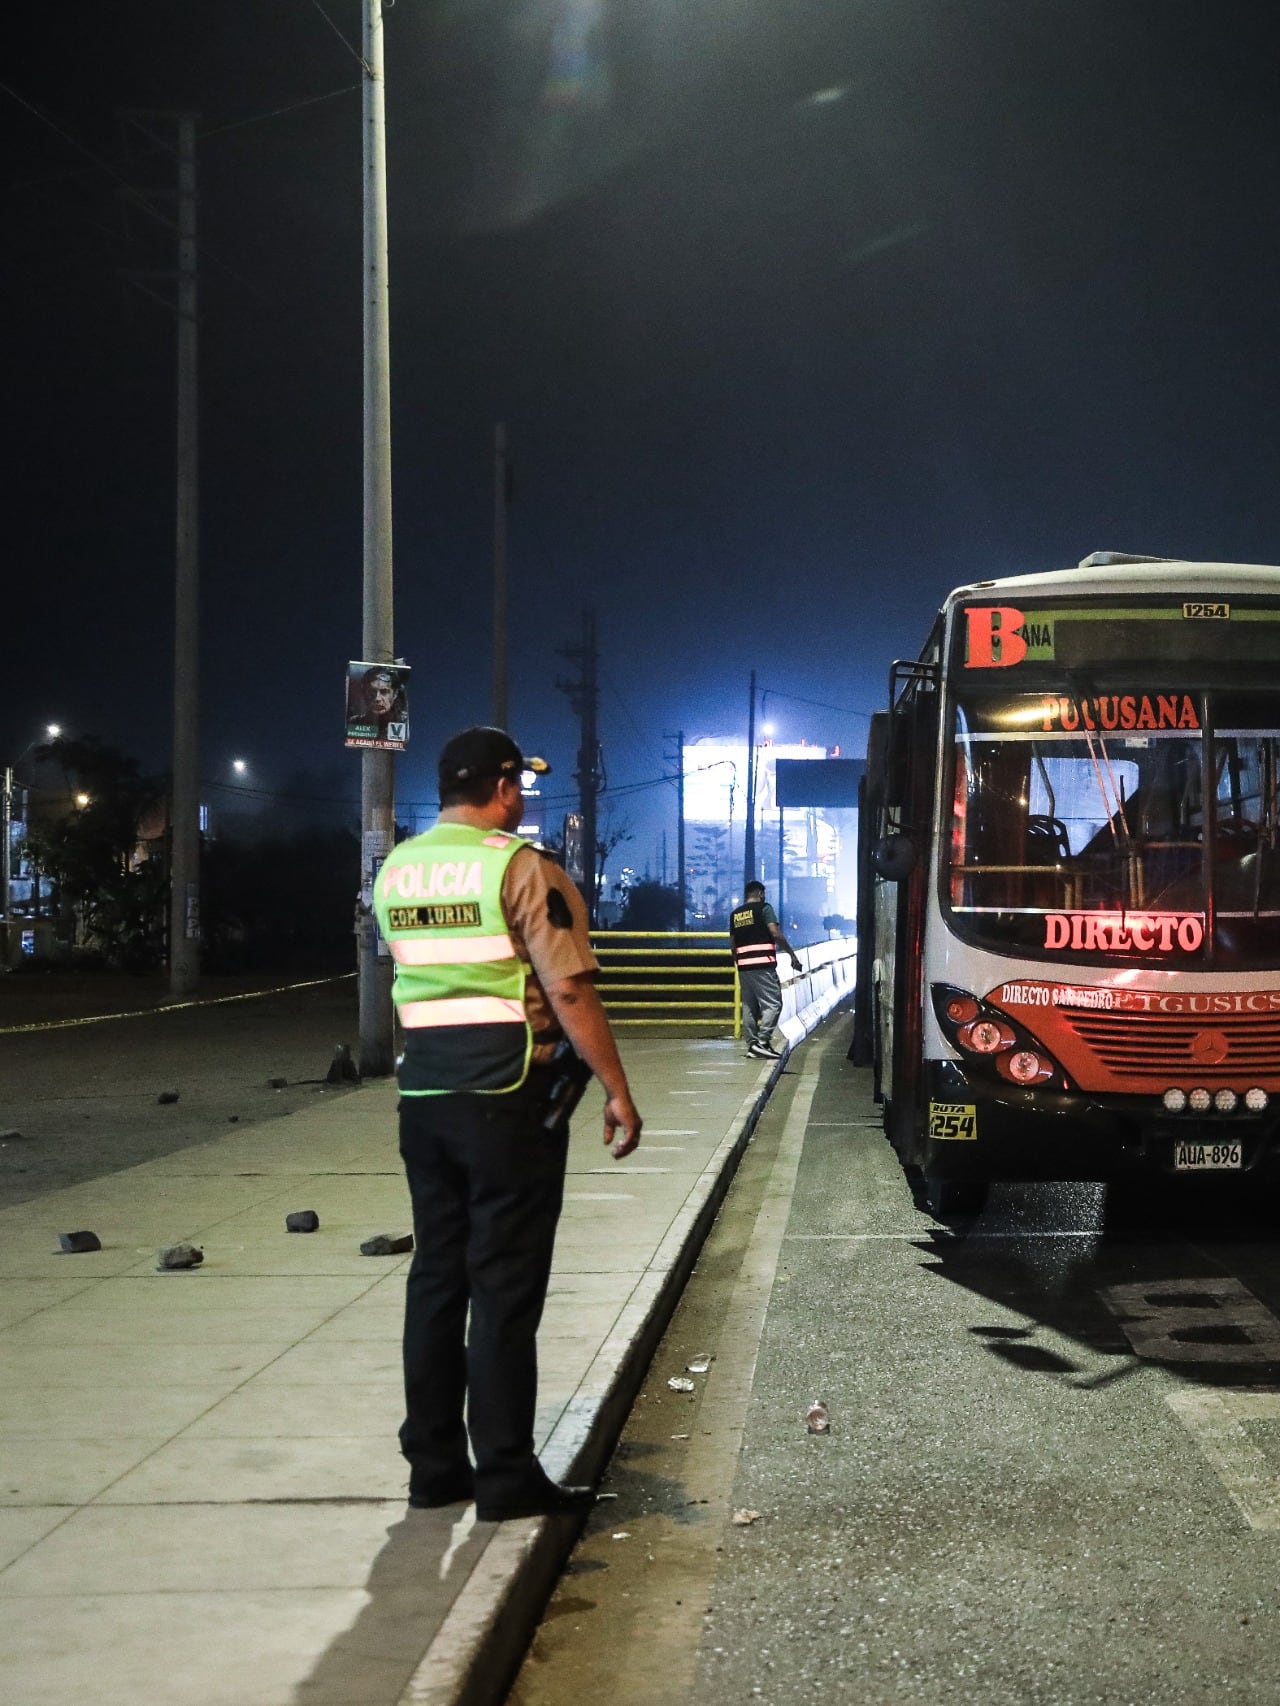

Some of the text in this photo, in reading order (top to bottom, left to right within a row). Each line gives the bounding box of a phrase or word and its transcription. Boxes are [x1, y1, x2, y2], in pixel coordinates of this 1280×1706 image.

[1185, 604, 1227, 617] 1254
[964, 607, 1027, 668] B
[384, 861, 482, 898] POLICIA
[390, 907, 423, 927] COM.
[1044, 914, 1203, 951] DIRECTO
[1002, 984, 1049, 1006] DIRECTO
[933, 1104, 966, 1113] RUTA
[1178, 1145, 1239, 1165] AUA-896
